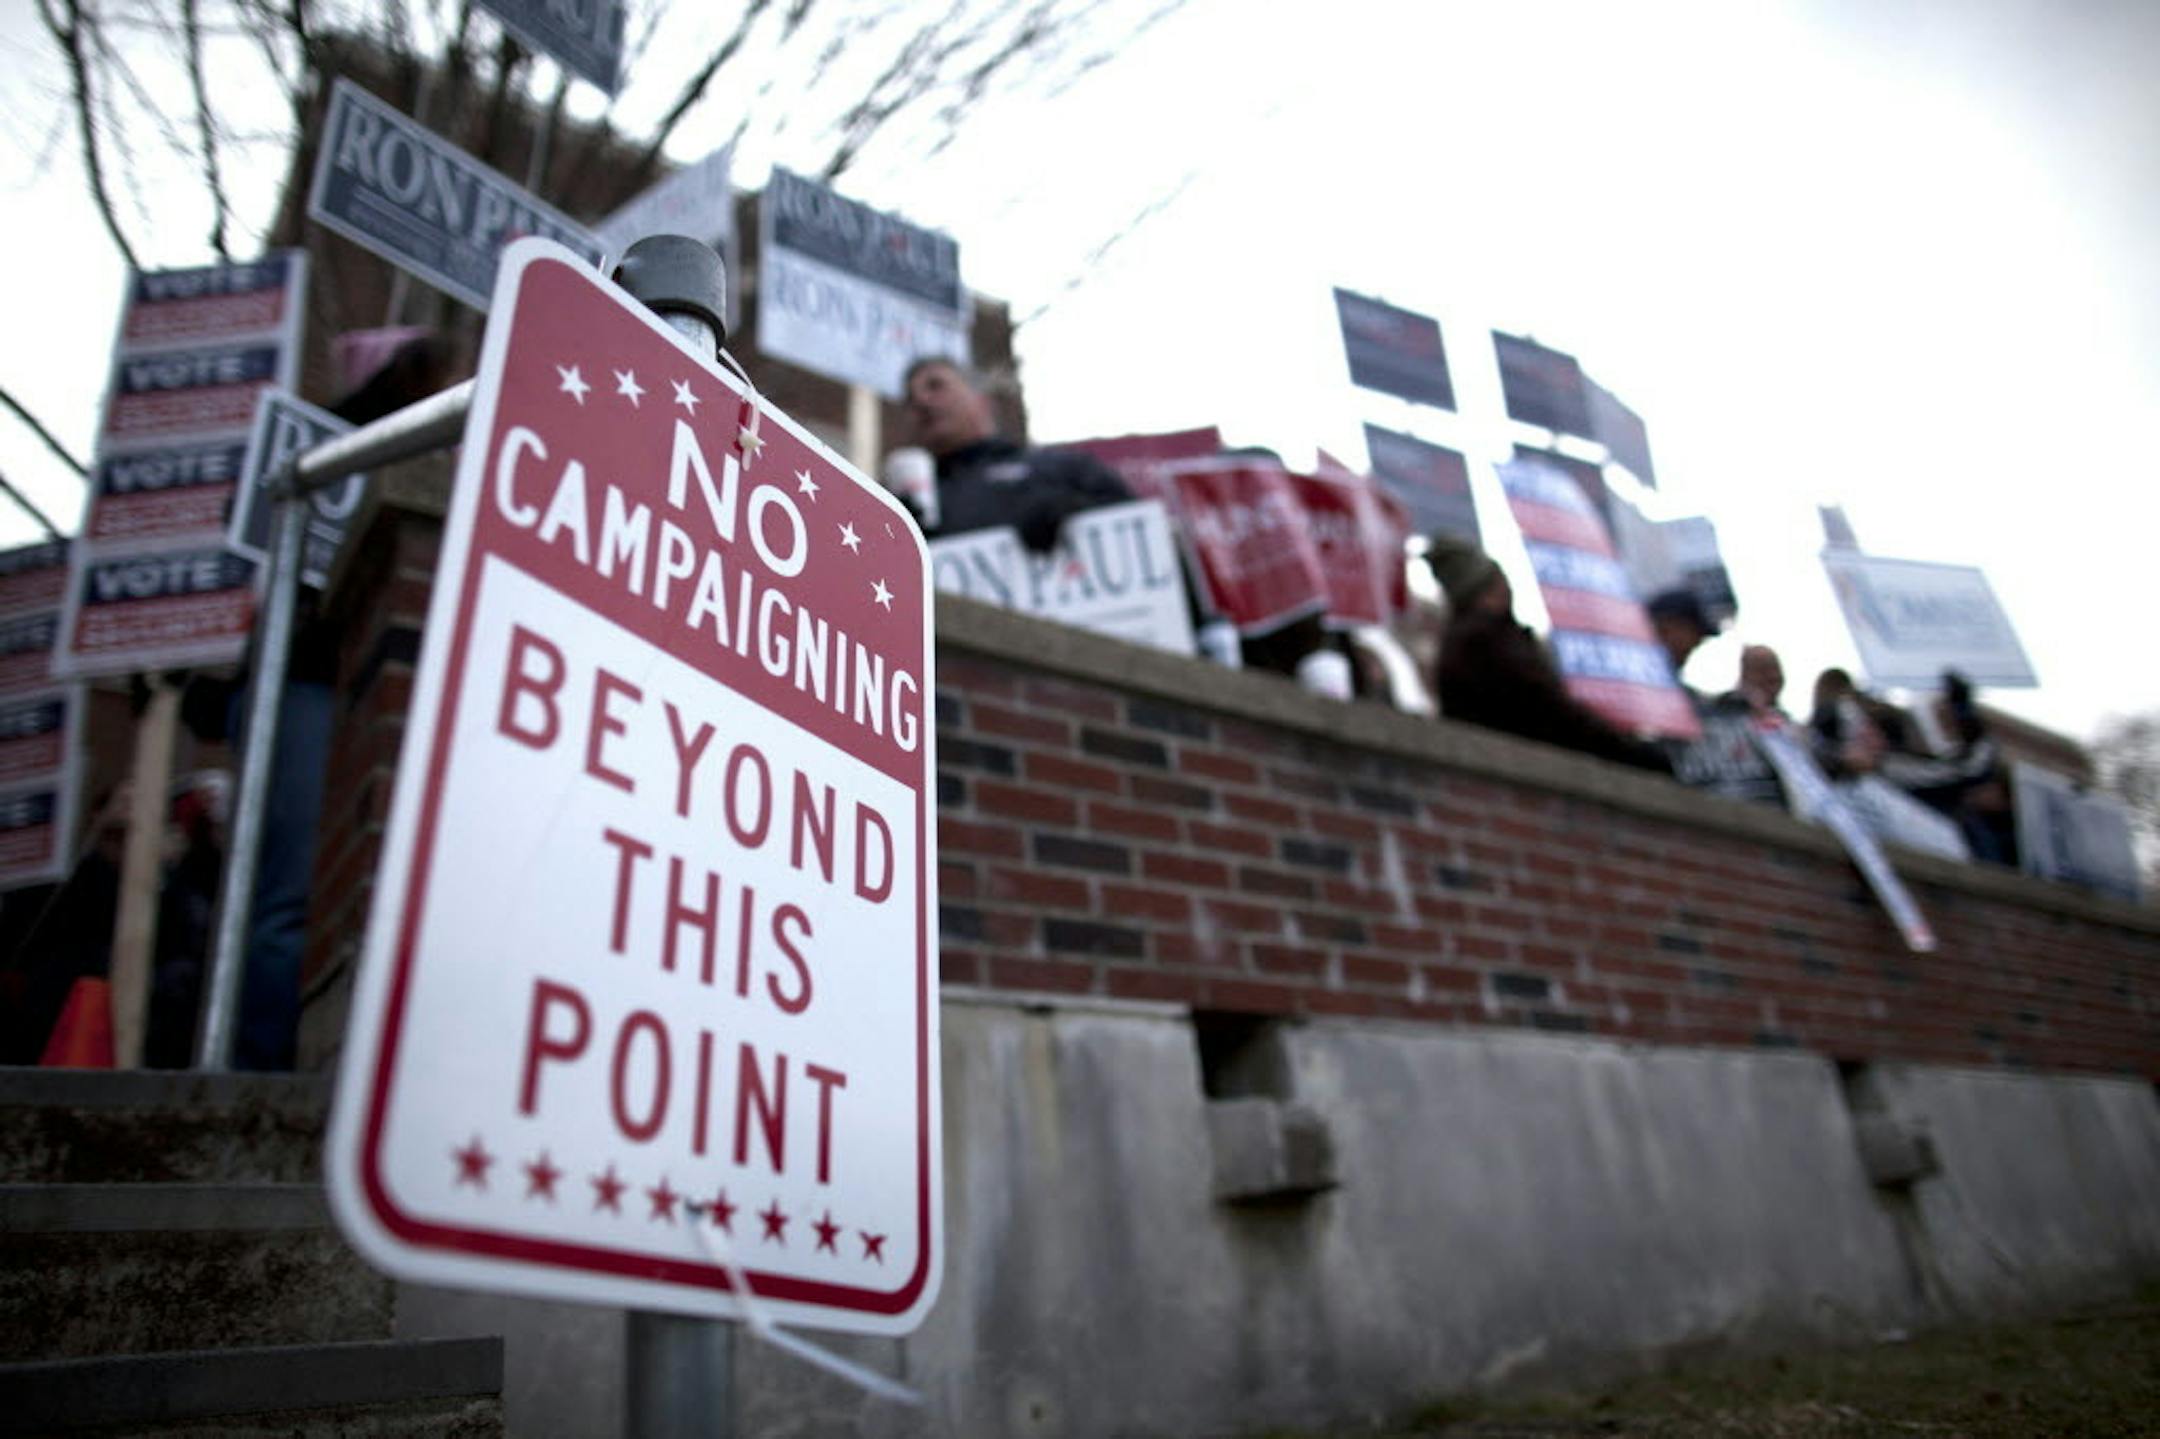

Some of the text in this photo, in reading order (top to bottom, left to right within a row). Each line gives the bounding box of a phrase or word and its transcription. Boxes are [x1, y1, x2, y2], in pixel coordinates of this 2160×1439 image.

[335, 106, 472, 237] RON
[128, 355, 246, 389] VOTE
[110, 454, 229, 491] VOTE
[667, 418, 808, 577] NO
[94, 559, 223, 598] VOTE
[496, 426, 917, 752] CAMPAIGNING
[496, 623, 895, 905] BEYOND
[602, 826, 814, 1016] THIS
[516, 975, 847, 1186] POINT
